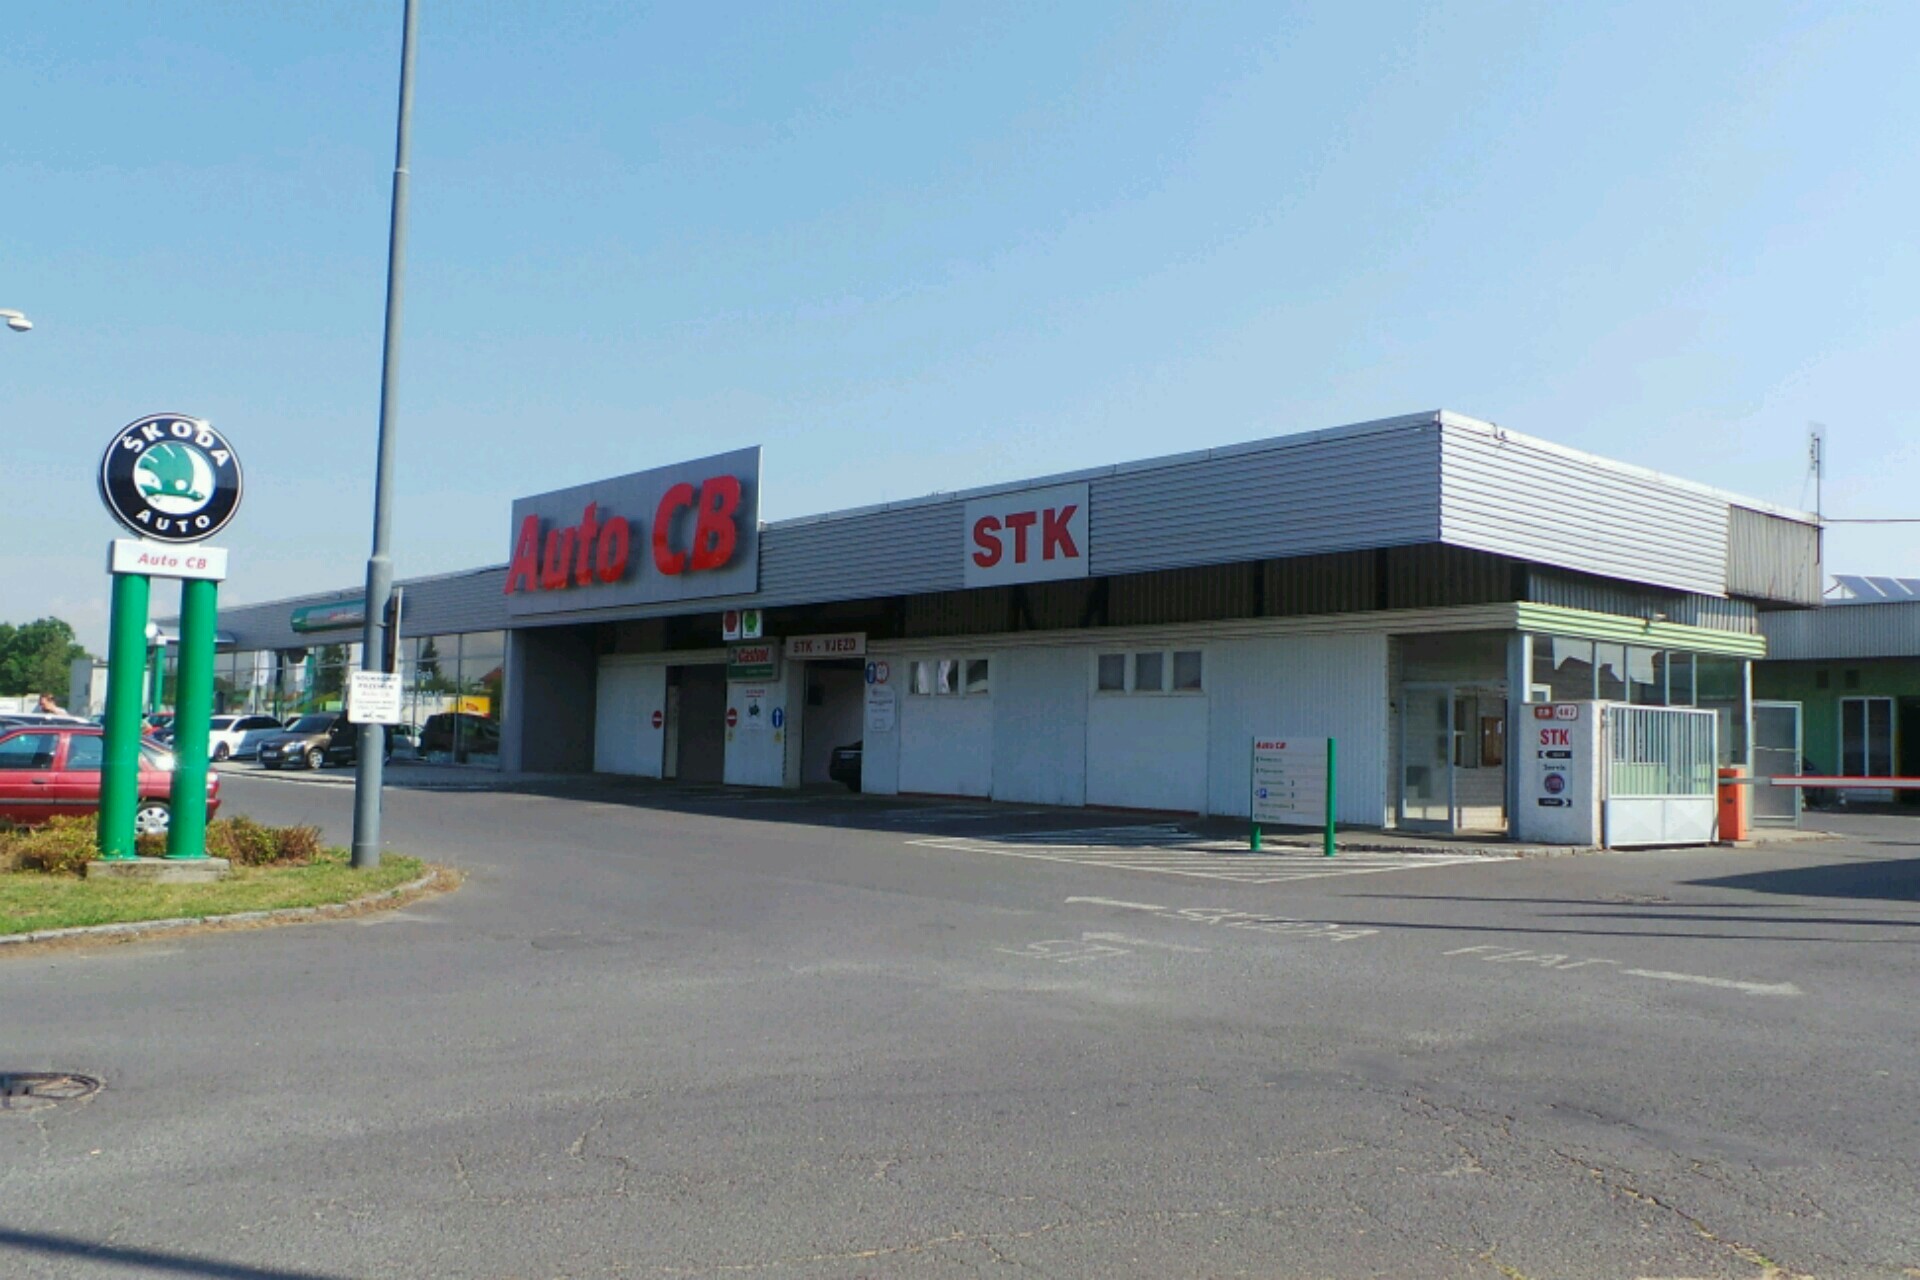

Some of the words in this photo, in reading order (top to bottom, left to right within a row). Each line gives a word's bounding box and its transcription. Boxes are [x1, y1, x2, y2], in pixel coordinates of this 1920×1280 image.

[136, 509, 211, 533] AUTO
[504, 500, 629, 596] Auto
[652, 474, 741, 576] CB
[972, 504, 1080, 568] STK
[138, 553, 178, 568] Auto
[185, 556, 207, 570] CB
[793, 639, 813, 653] STK
[824, 637, 856, 652] VJEZD
[1540, 728, 1569, 746] STK
